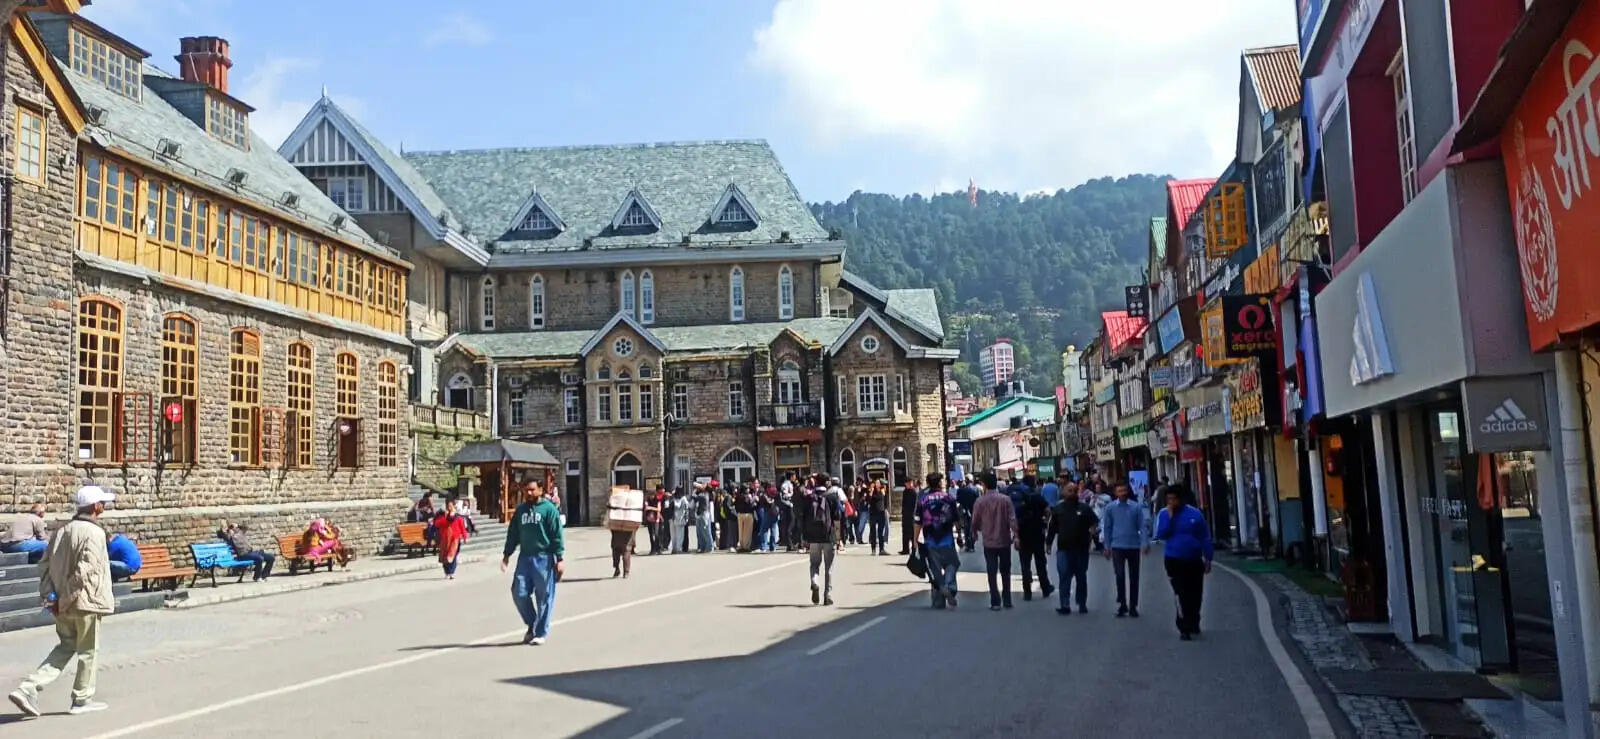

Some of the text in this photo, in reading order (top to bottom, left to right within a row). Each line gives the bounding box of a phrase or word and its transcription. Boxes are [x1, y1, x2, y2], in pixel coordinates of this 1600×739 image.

[1231, 343, 1276, 353] degrees
[1480, 417, 1537, 433] adidas
[521, 511, 542, 525] GAP
